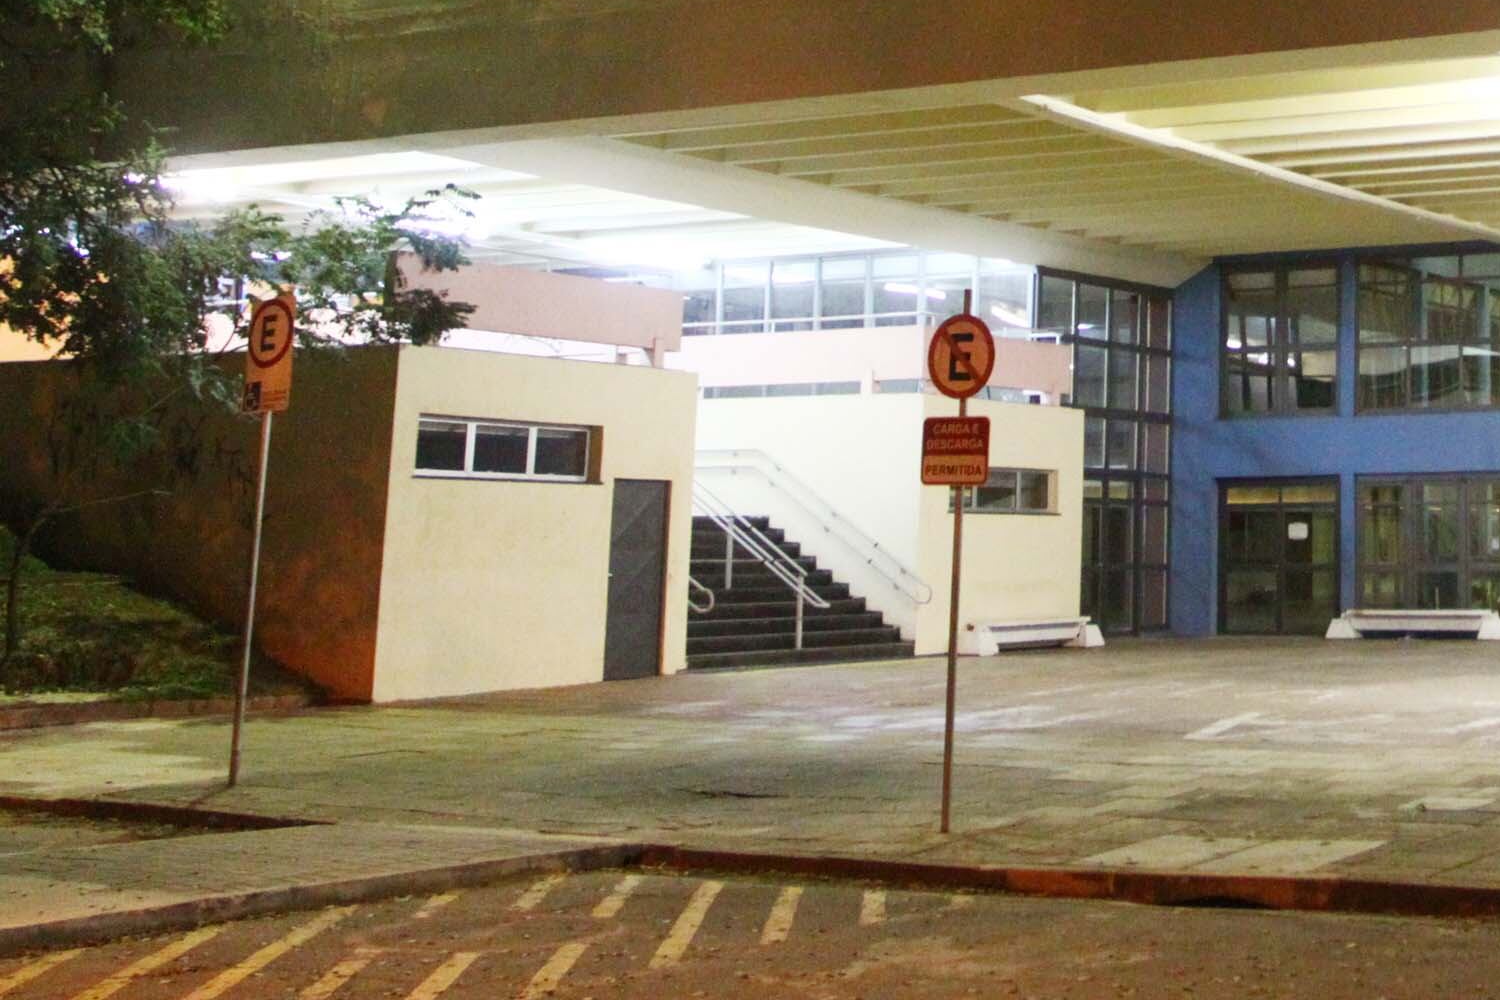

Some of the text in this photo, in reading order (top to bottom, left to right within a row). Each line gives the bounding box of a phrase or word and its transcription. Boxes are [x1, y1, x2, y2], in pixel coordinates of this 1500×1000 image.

[260, 314, 278, 352] E
[948, 332, 974, 381] E
[932, 423, 969, 434] CARGA
[926, 438, 983, 450] DESCARGA
[924, 463, 983, 476] PERMITIDA
